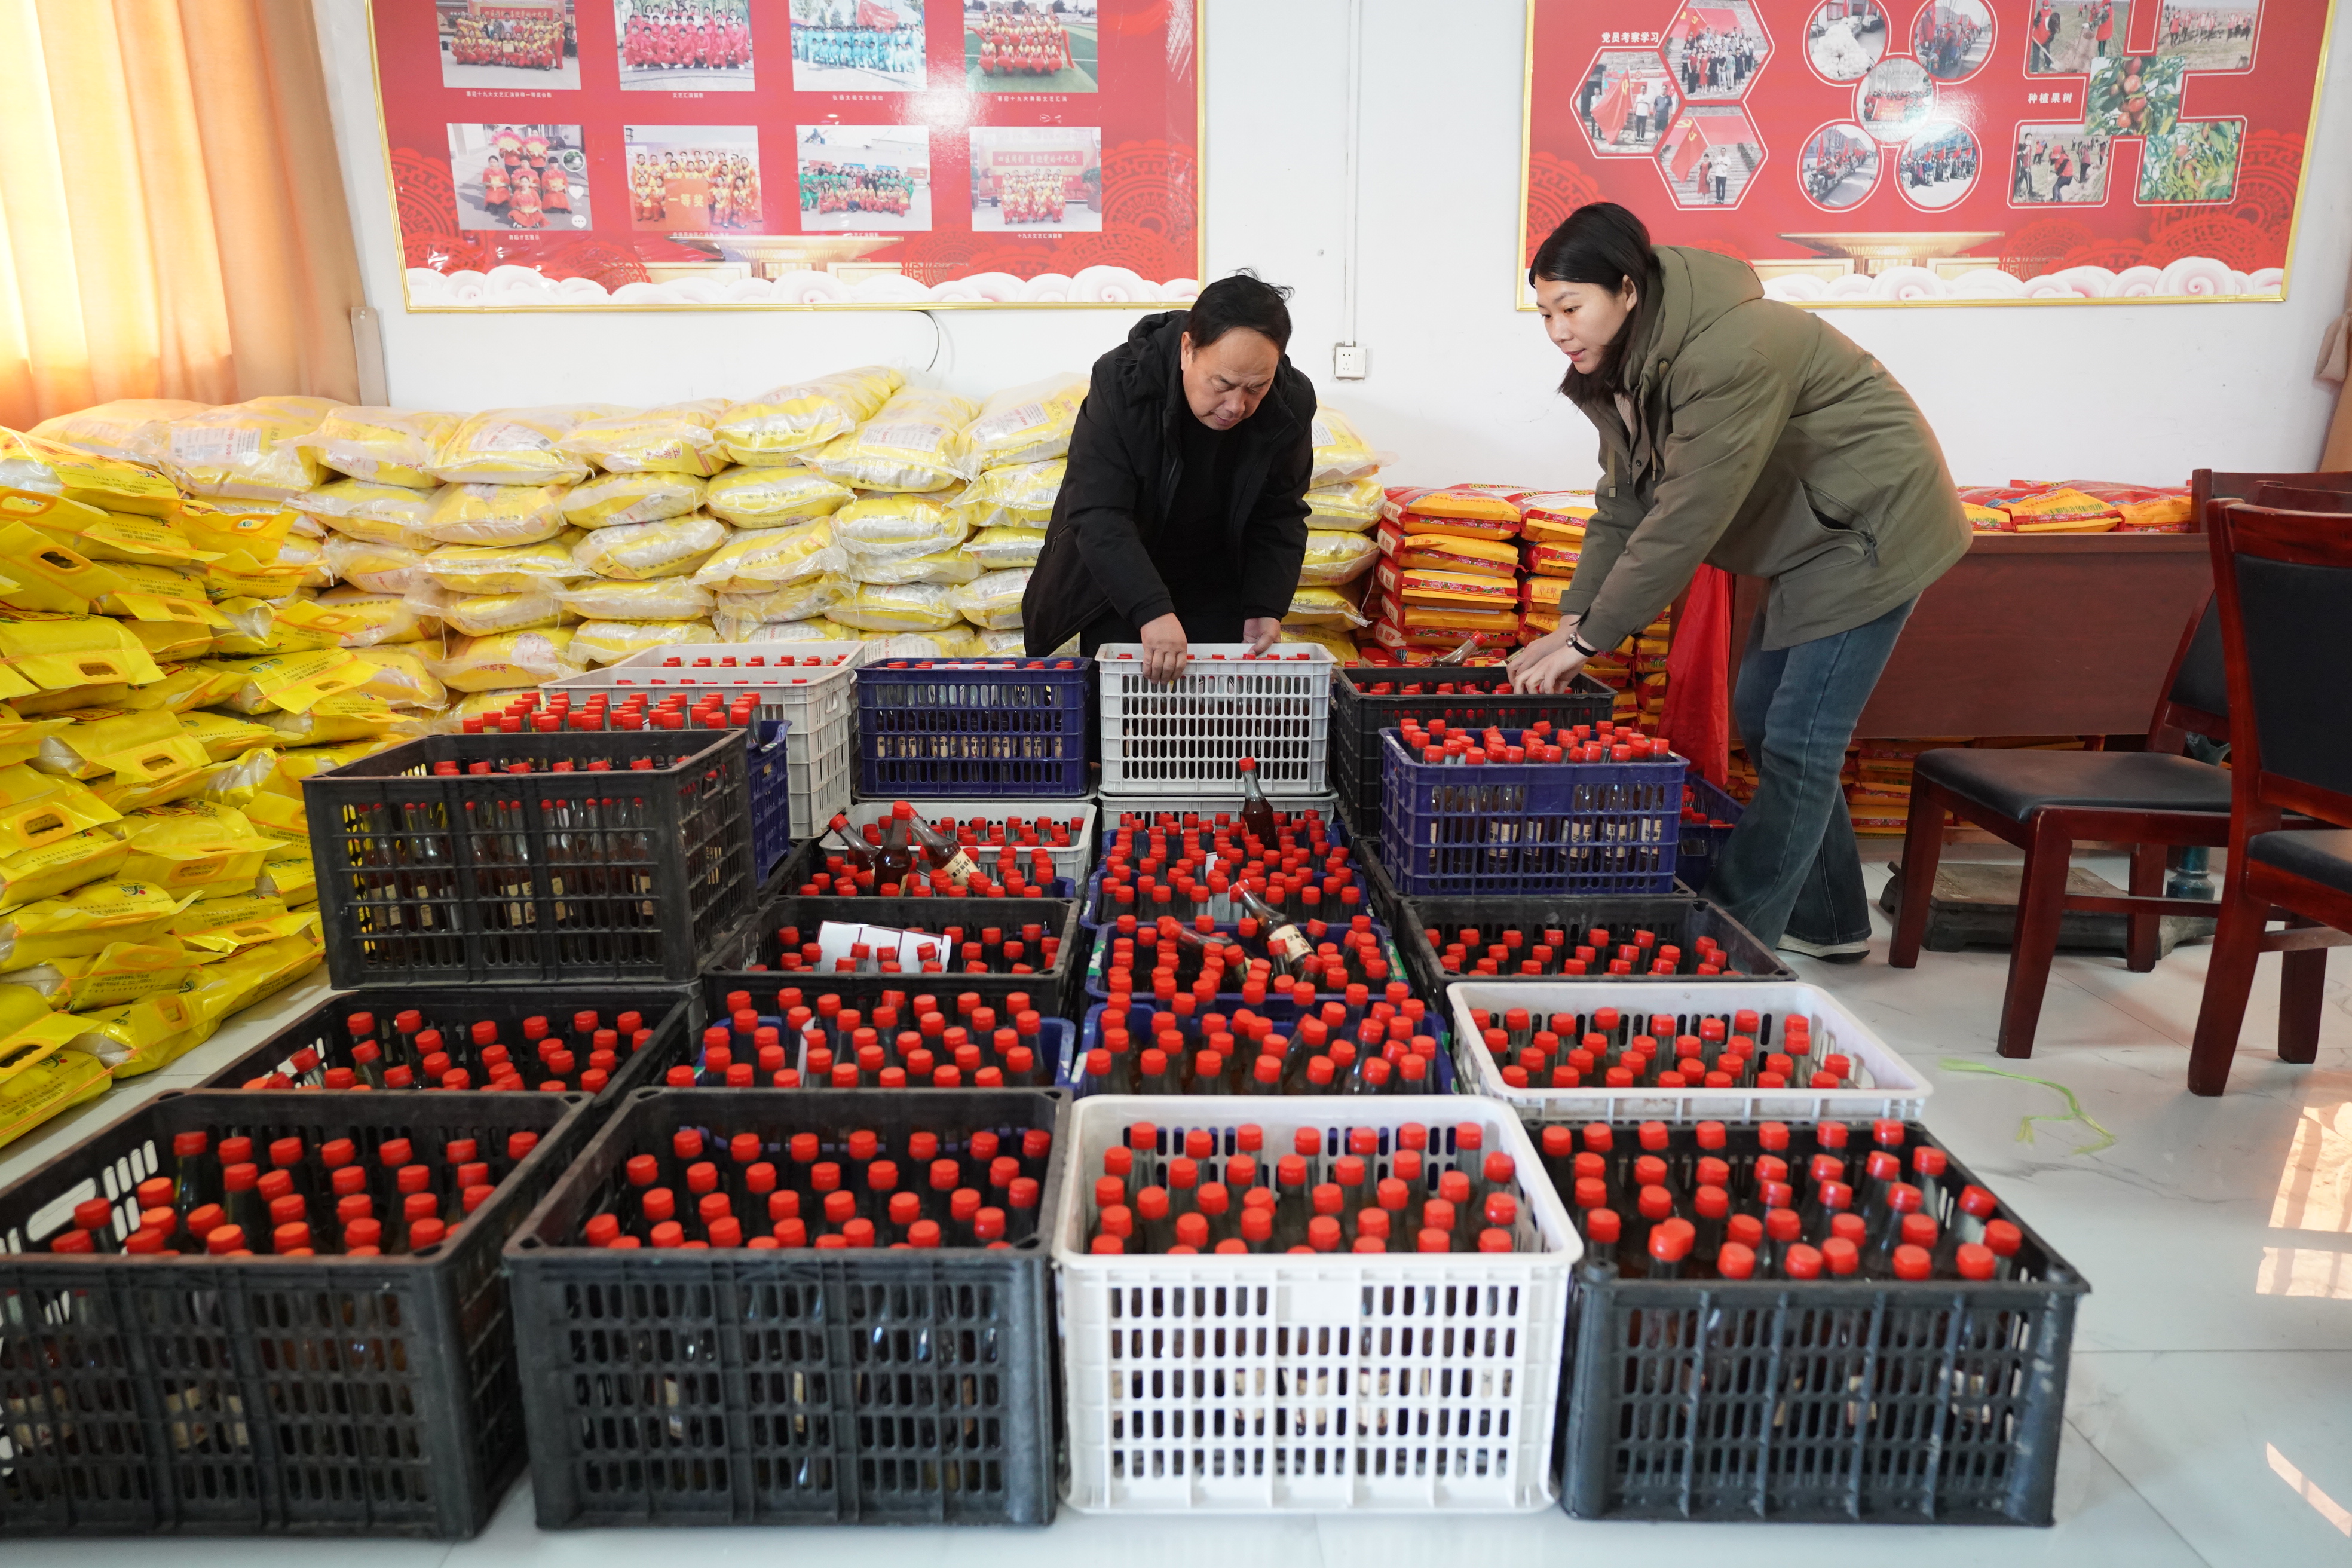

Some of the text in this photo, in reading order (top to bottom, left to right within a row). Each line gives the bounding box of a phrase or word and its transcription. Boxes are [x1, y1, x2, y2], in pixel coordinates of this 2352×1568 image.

[1601, 32, 1659, 43] 党员考察学习
[2028, 92, 2073, 104] 种植果树
[668, 193, 704, 207] 一等奖
